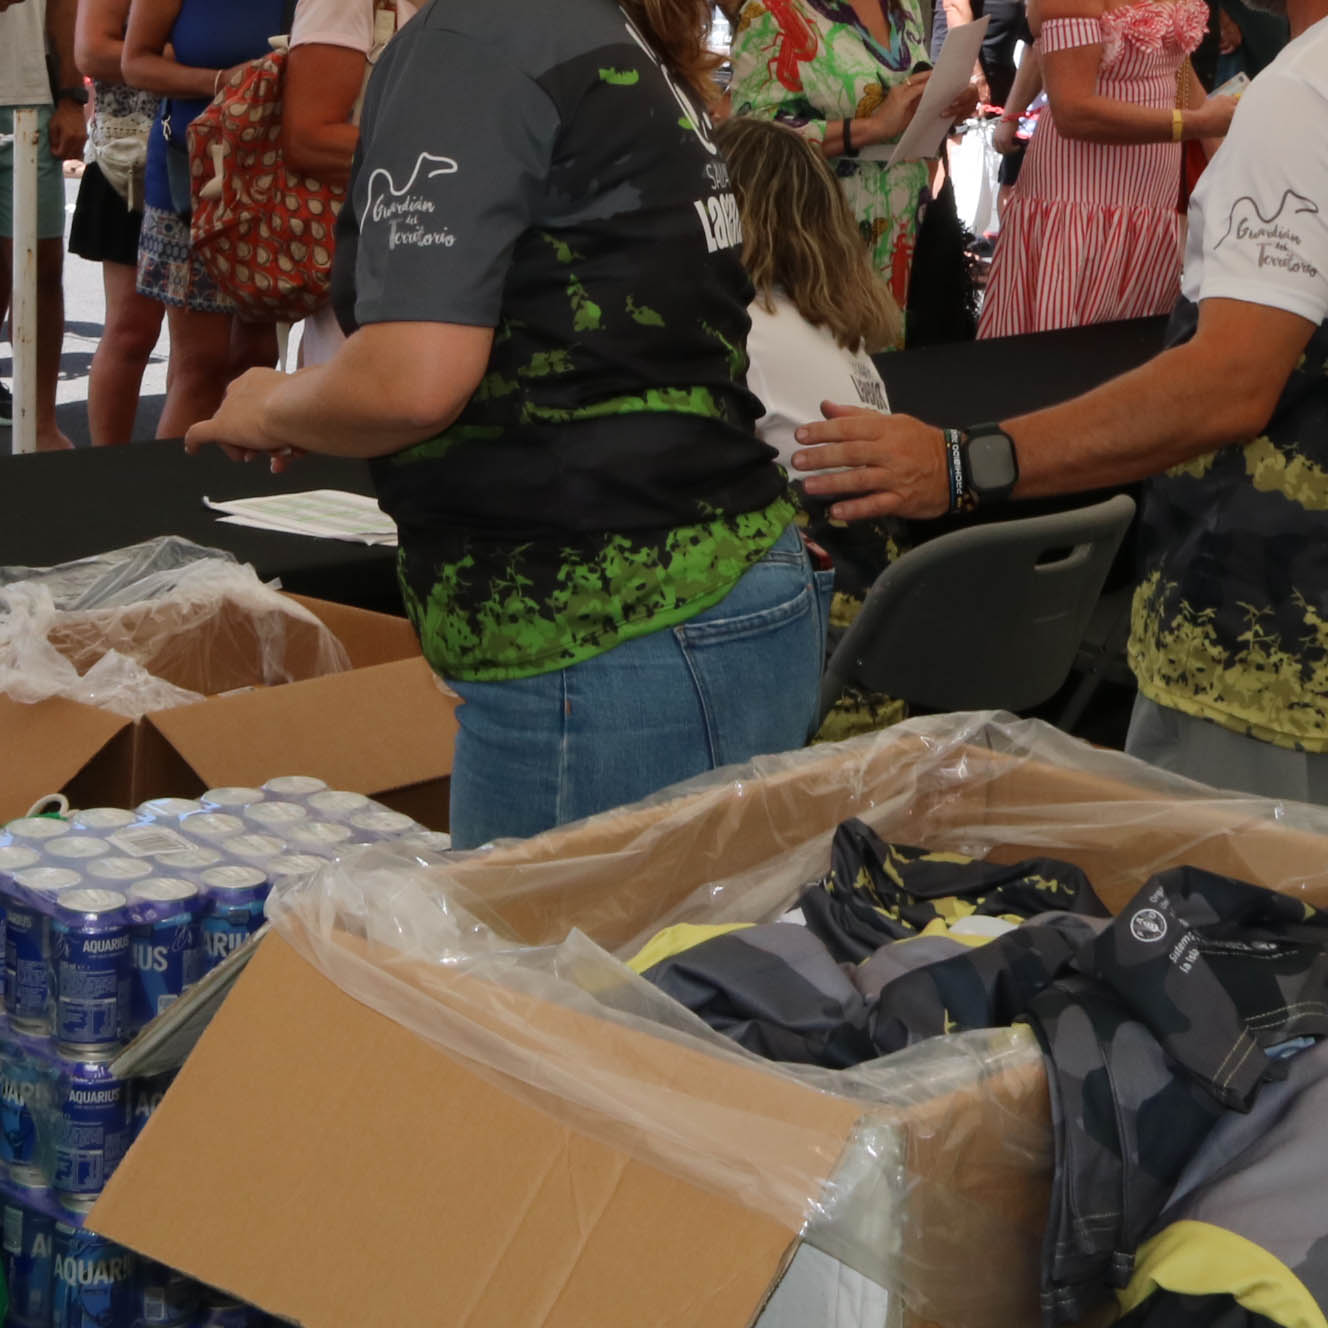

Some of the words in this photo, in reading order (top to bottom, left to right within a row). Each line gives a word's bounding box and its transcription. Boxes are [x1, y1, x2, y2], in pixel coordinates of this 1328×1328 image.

[388, 217, 456, 251] Territorio
[82, 934, 131, 954] AQUARIUS
[69, 1087, 121, 1106] AQUARIUS
